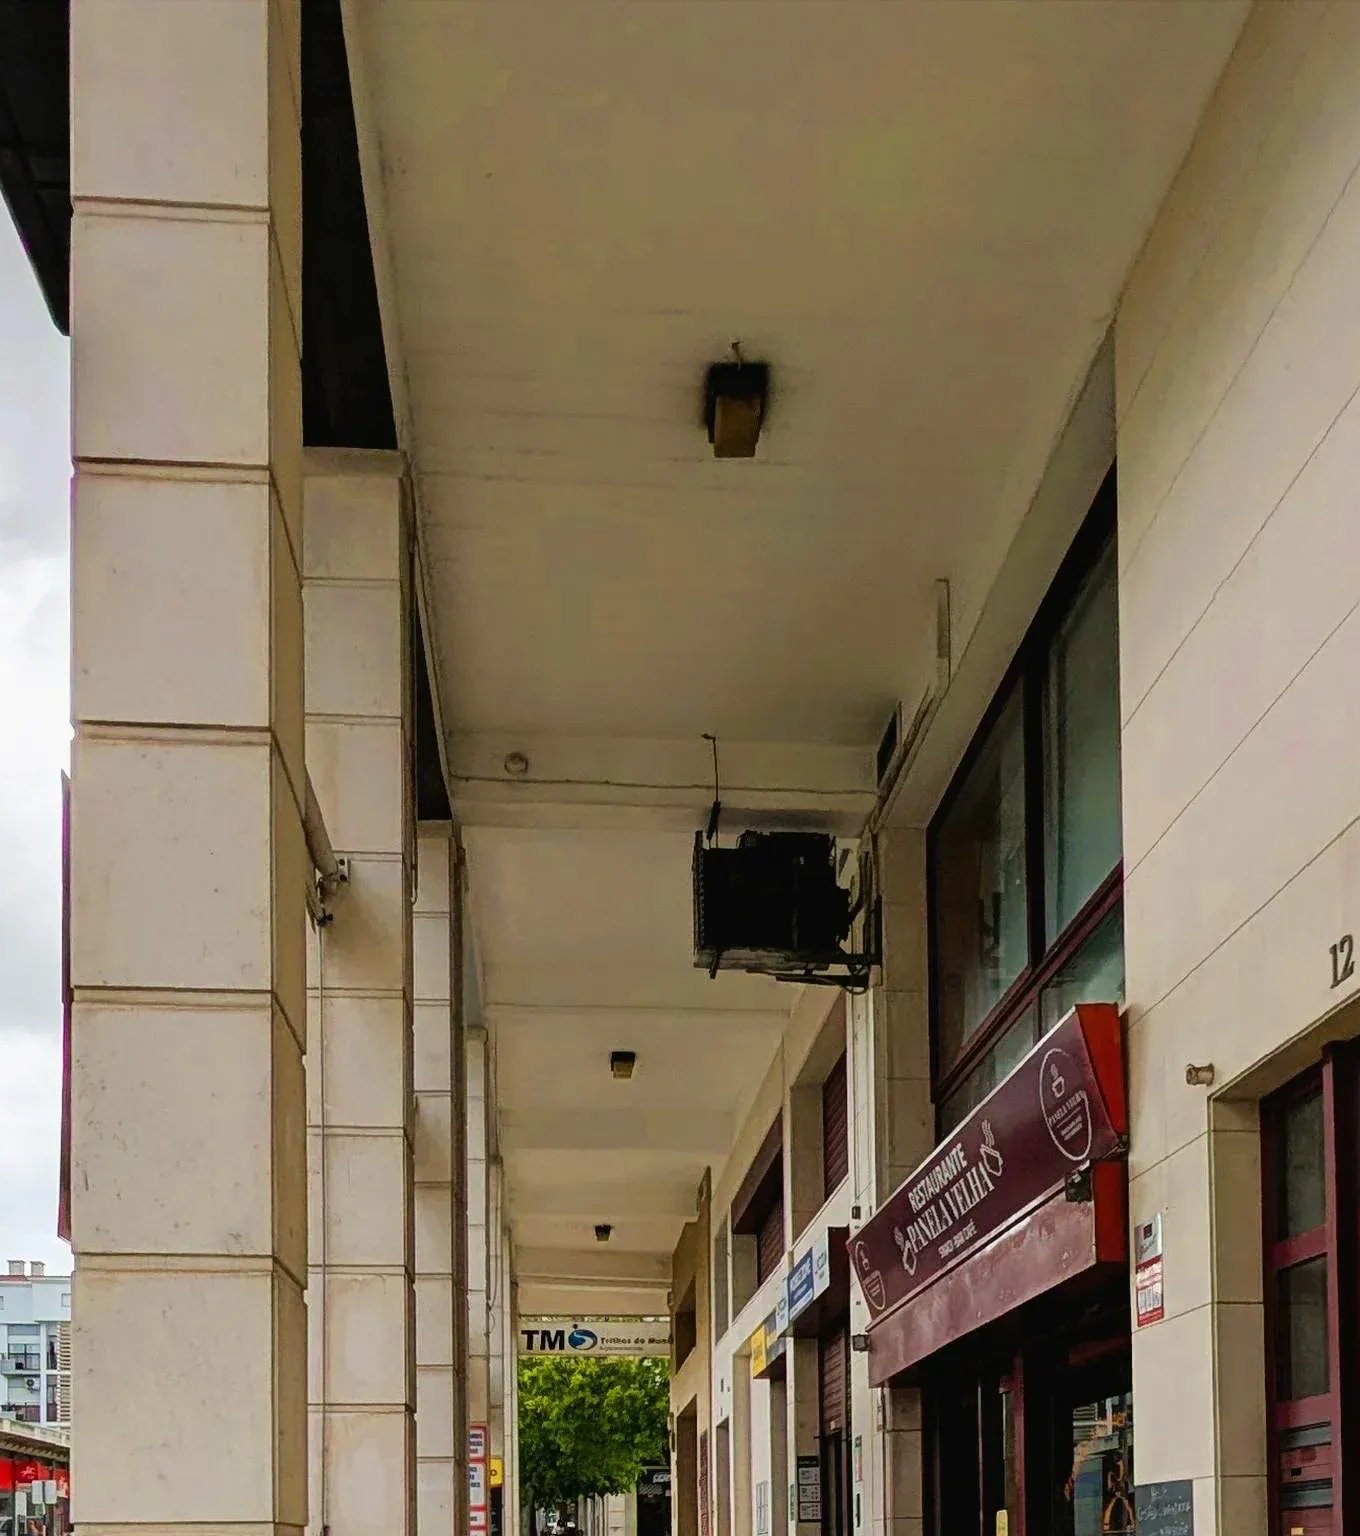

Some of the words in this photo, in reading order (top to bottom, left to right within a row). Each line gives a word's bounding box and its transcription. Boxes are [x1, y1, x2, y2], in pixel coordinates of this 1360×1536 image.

[1328, 933, 1355, 990] 12
[906, 1198, 954, 1254] PANELA
[944, 1161, 995, 1221] VELHA
[907, 1142, 967, 1214] RESTAURANTE
[520, 1329, 566, 1351] TM
